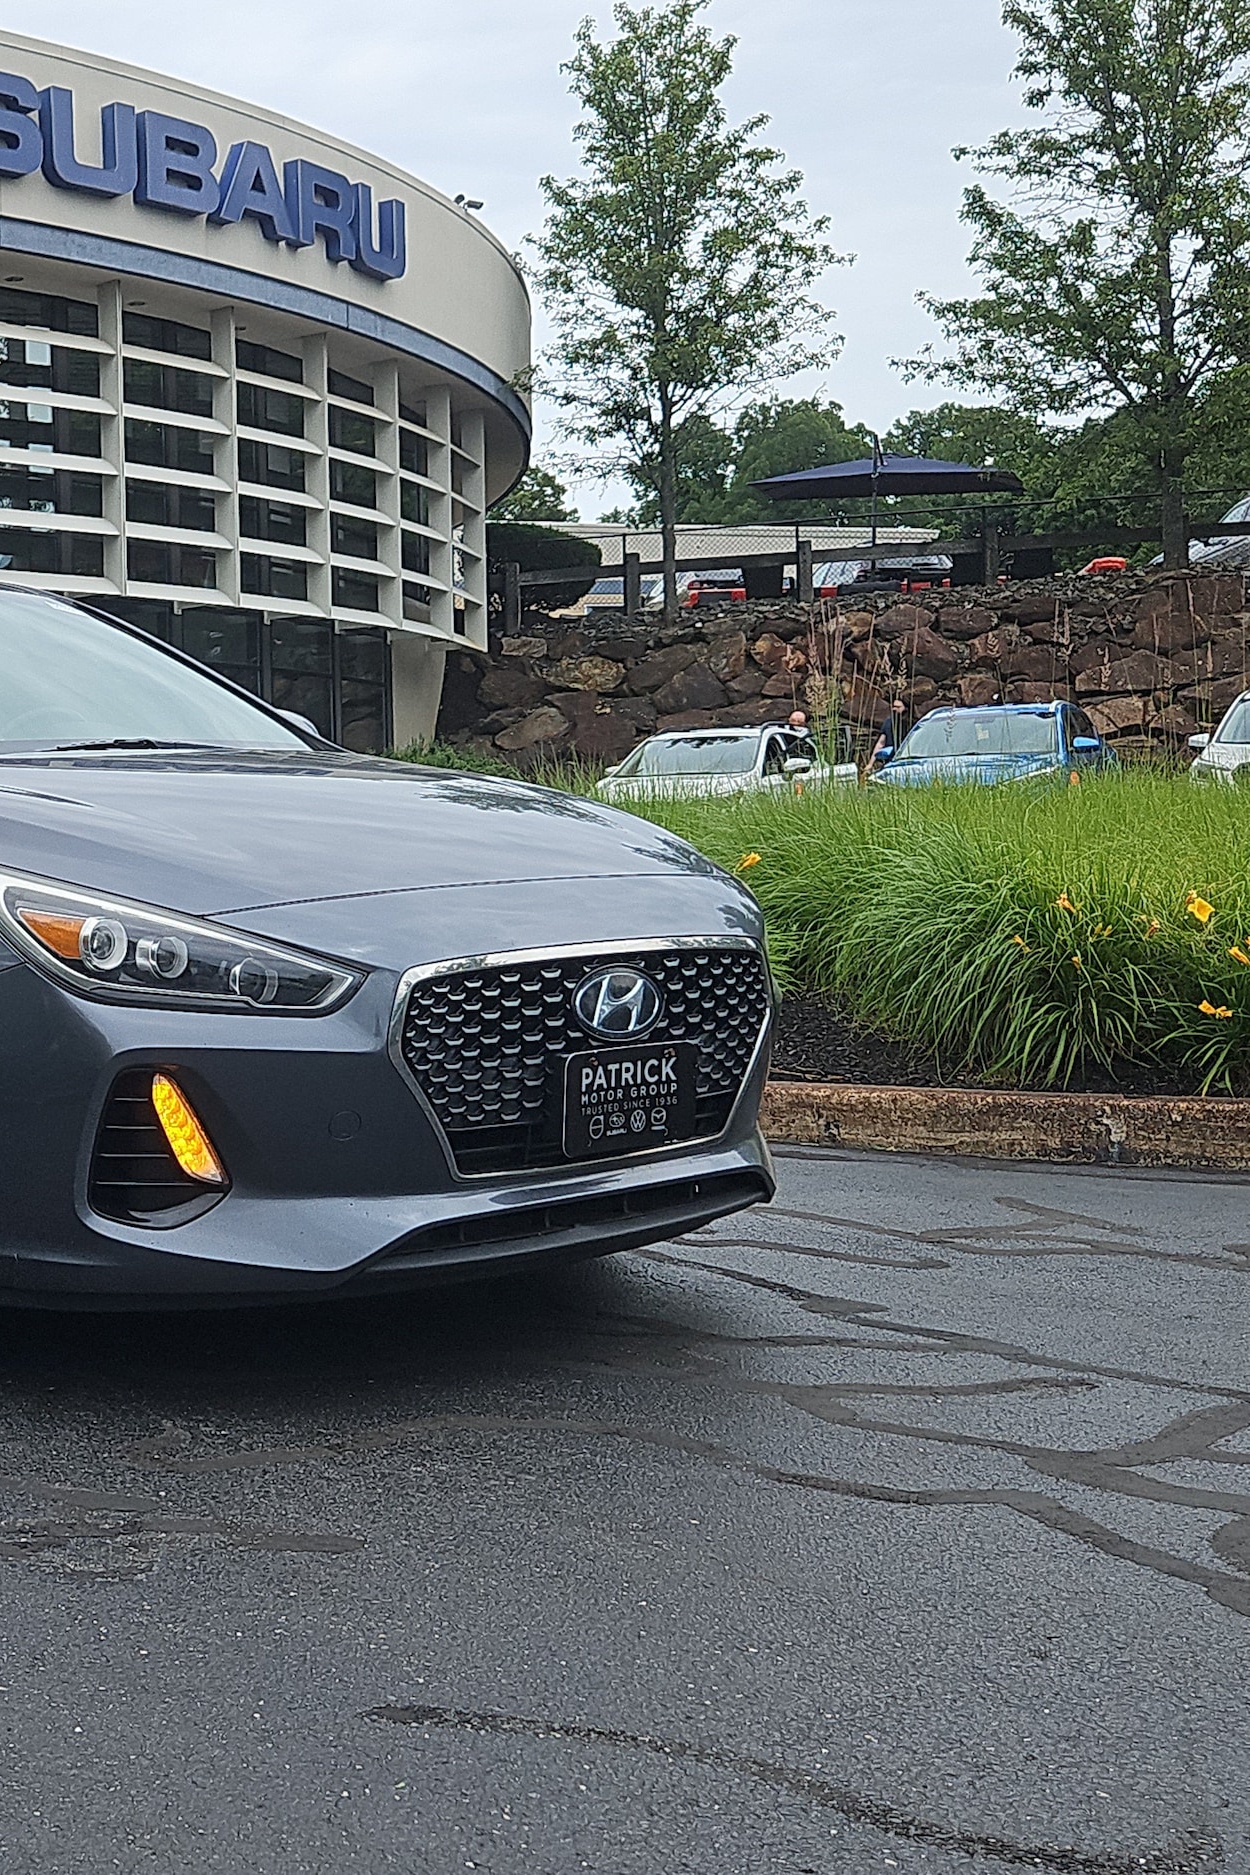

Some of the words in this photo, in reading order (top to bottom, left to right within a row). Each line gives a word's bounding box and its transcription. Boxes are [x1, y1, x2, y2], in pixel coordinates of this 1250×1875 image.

[581, 1056, 678, 1092] PATRICK
[581, 1088, 624, 1106] MOTOR
[630, 1082, 678, 1098] GROUP
[581, 1102, 620, 1116] TRUSTED
[623, 1098, 651, 1110] SINCE
[655, 1095, 678, 1107] 1936
